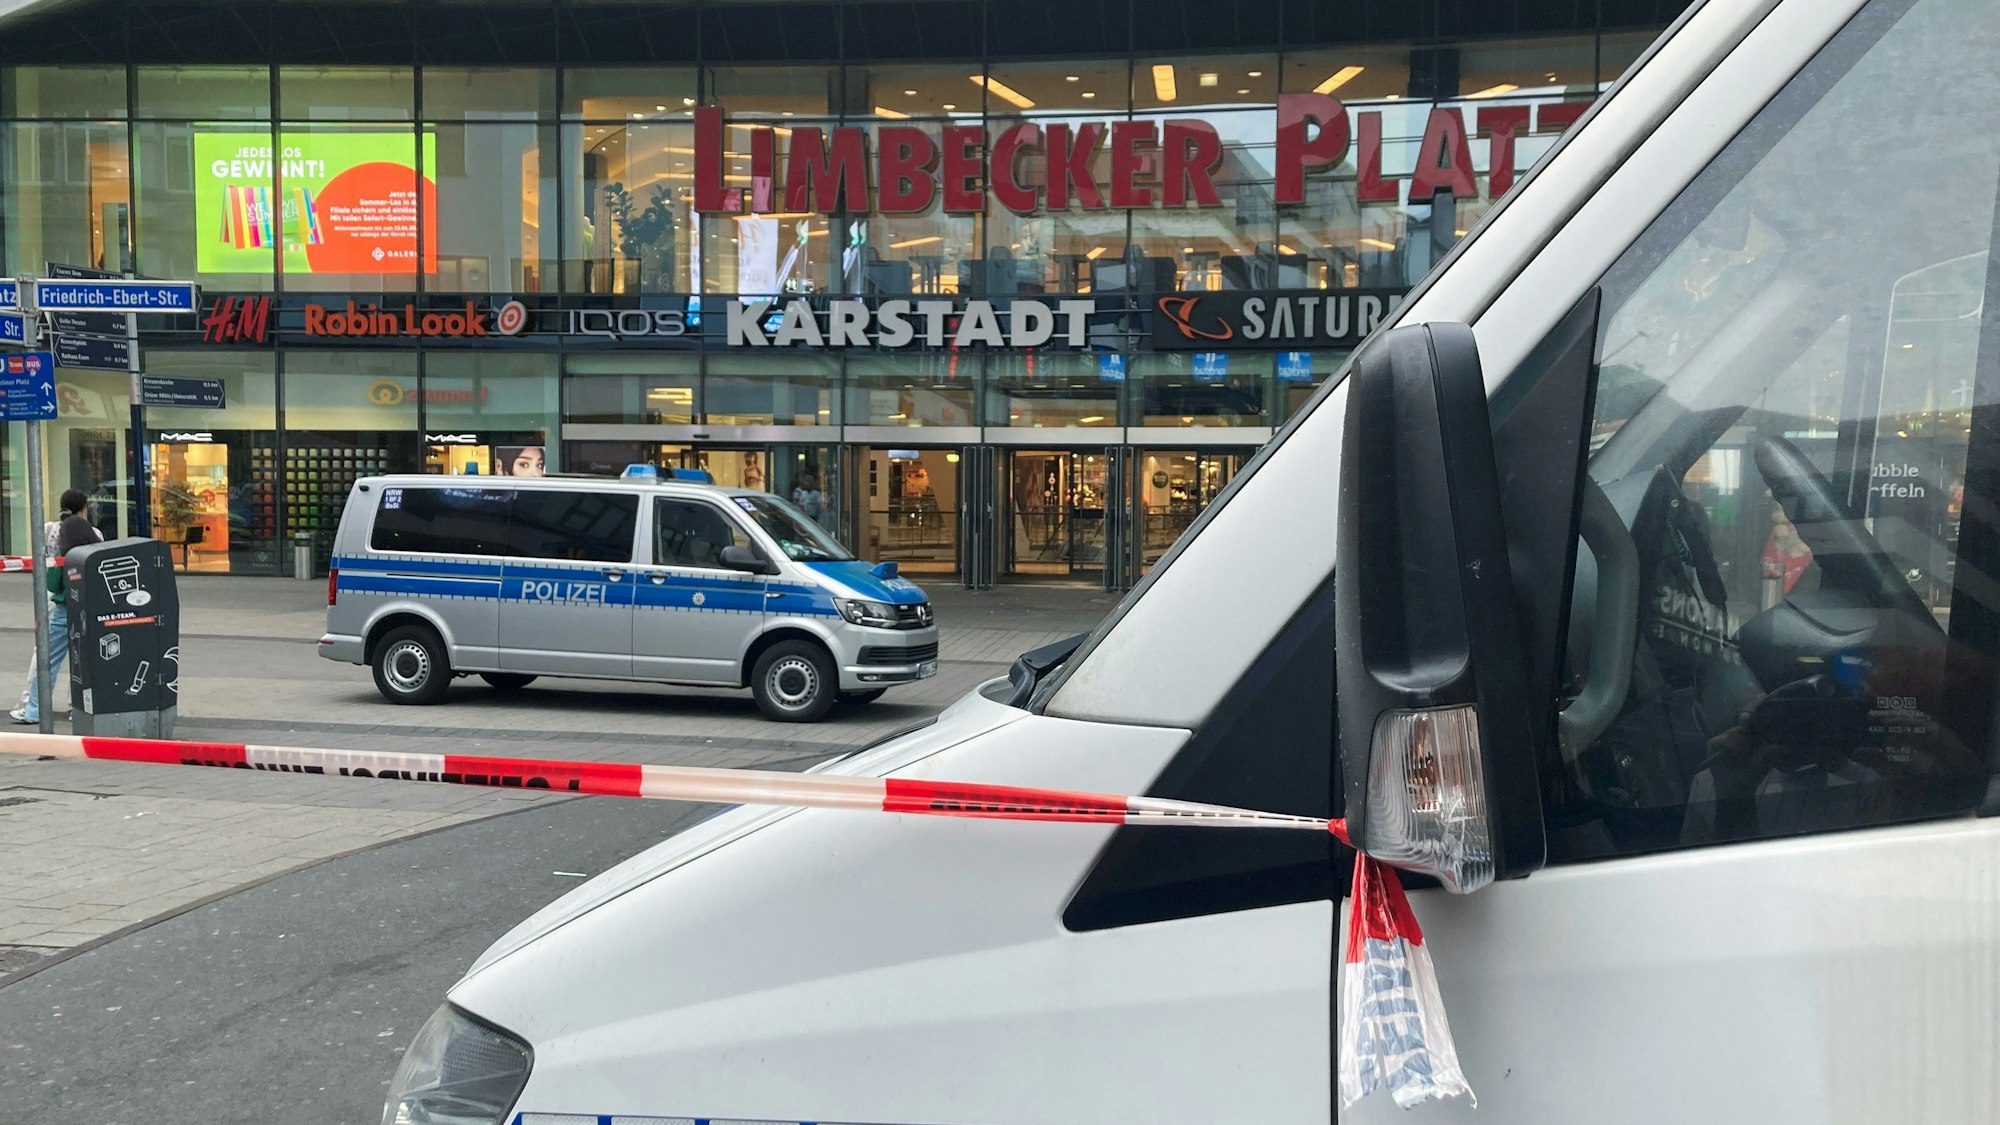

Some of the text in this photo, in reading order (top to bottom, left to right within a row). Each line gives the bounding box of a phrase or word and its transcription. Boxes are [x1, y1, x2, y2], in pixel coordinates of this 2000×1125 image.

[236, 147, 302, 158] JEDES OS
[694, 105, 1225, 215] LIMBECKER
[330, 206, 416, 214] Filiale sichern und einlöse
[387, 250, 417, 258] GALERI
[41, 287, 183, 306] Friedrich-Ebert-Str.
[202, 295, 271, 343] H&M
[304, 299, 487, 336] Robin Look
[569, 308, 686, 340] IQOS
[726, 299, 1097, 347] KARSTADT
[4, 319, 21, 337] Str.
[160, 432, 213, 442] MAC
[425, 434, 477, 443] MAC
[521, 580, 607, 603] POLIZEI
